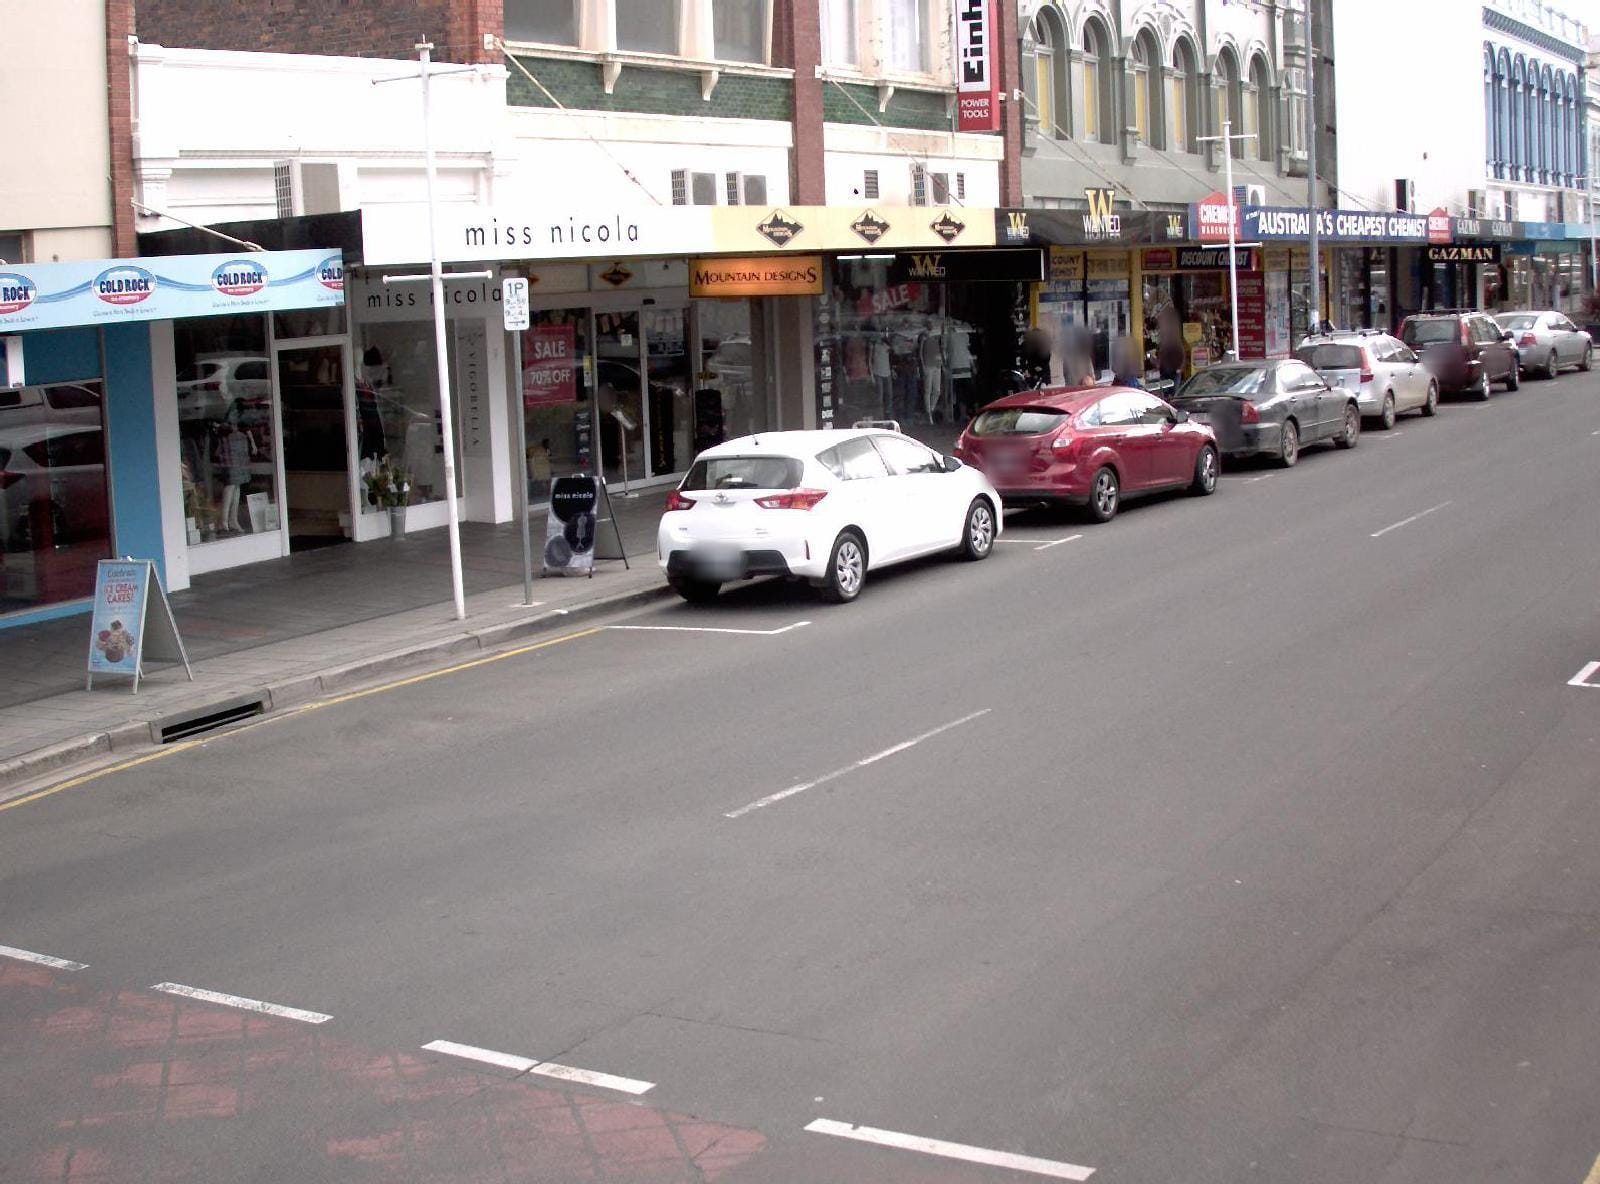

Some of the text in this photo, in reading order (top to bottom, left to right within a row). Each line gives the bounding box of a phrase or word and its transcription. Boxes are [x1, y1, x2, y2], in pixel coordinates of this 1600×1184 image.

[961, 99, 989, 107] POWER
[962, 109, 989, 118] TOOLS
[466, 215, 638, 245] miss nicola
[1083, 215, 1120, 233] WANTED
[1336, 214, 1386, 236] CHEAPEST
[1388, 217, 1426, 237] CHEMIST
[1428, 247, 1493, 260] GAZMAN
[217, 271, 263, 286] COLD ROCK
[695, 266, 817, 286] MOUNTAIN DESIGNS
[2, 285, 31, 301] ROCK
[100, 278, 150, 294] COLD ROCK
[507, 282, 524, 295] 1P
[368, 289, 415, 308] miss
[872, 284, 910, 313] SALE
[534, 340, 567, 359] SALE
